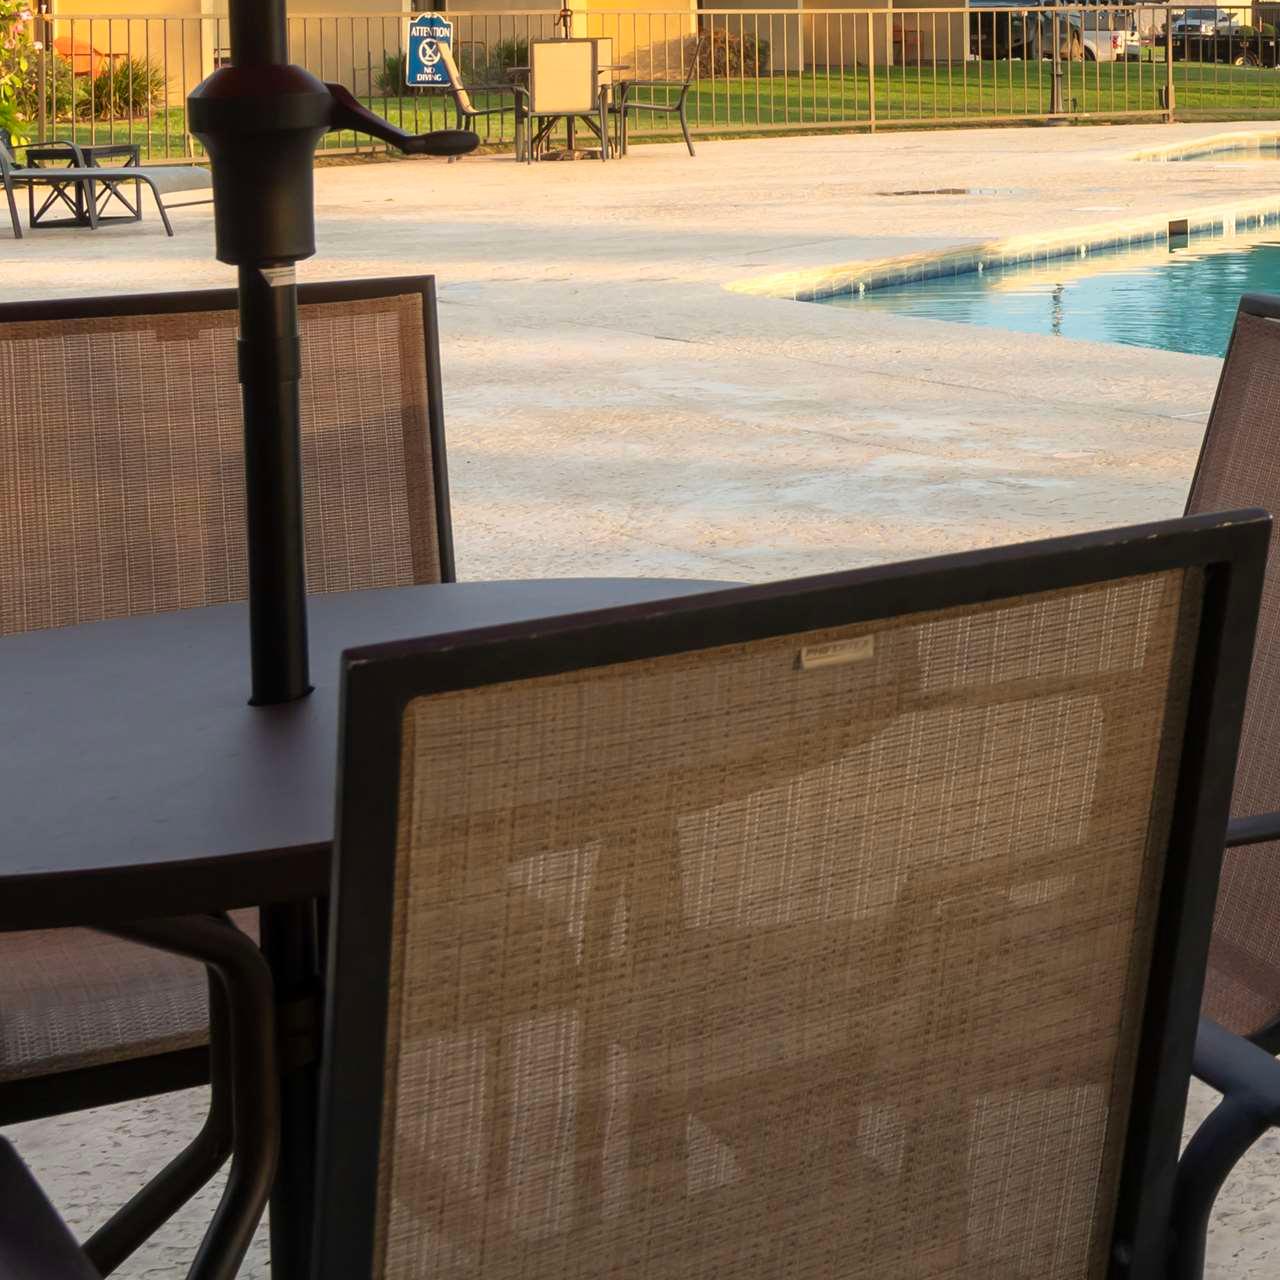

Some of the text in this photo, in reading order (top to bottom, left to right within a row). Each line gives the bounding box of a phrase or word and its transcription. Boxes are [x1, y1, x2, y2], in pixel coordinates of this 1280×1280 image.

[411, 26, 450, 37] ATTENTION
[424, 66, 436, 74] NO
[416, 73, 442, 82] DIVING
